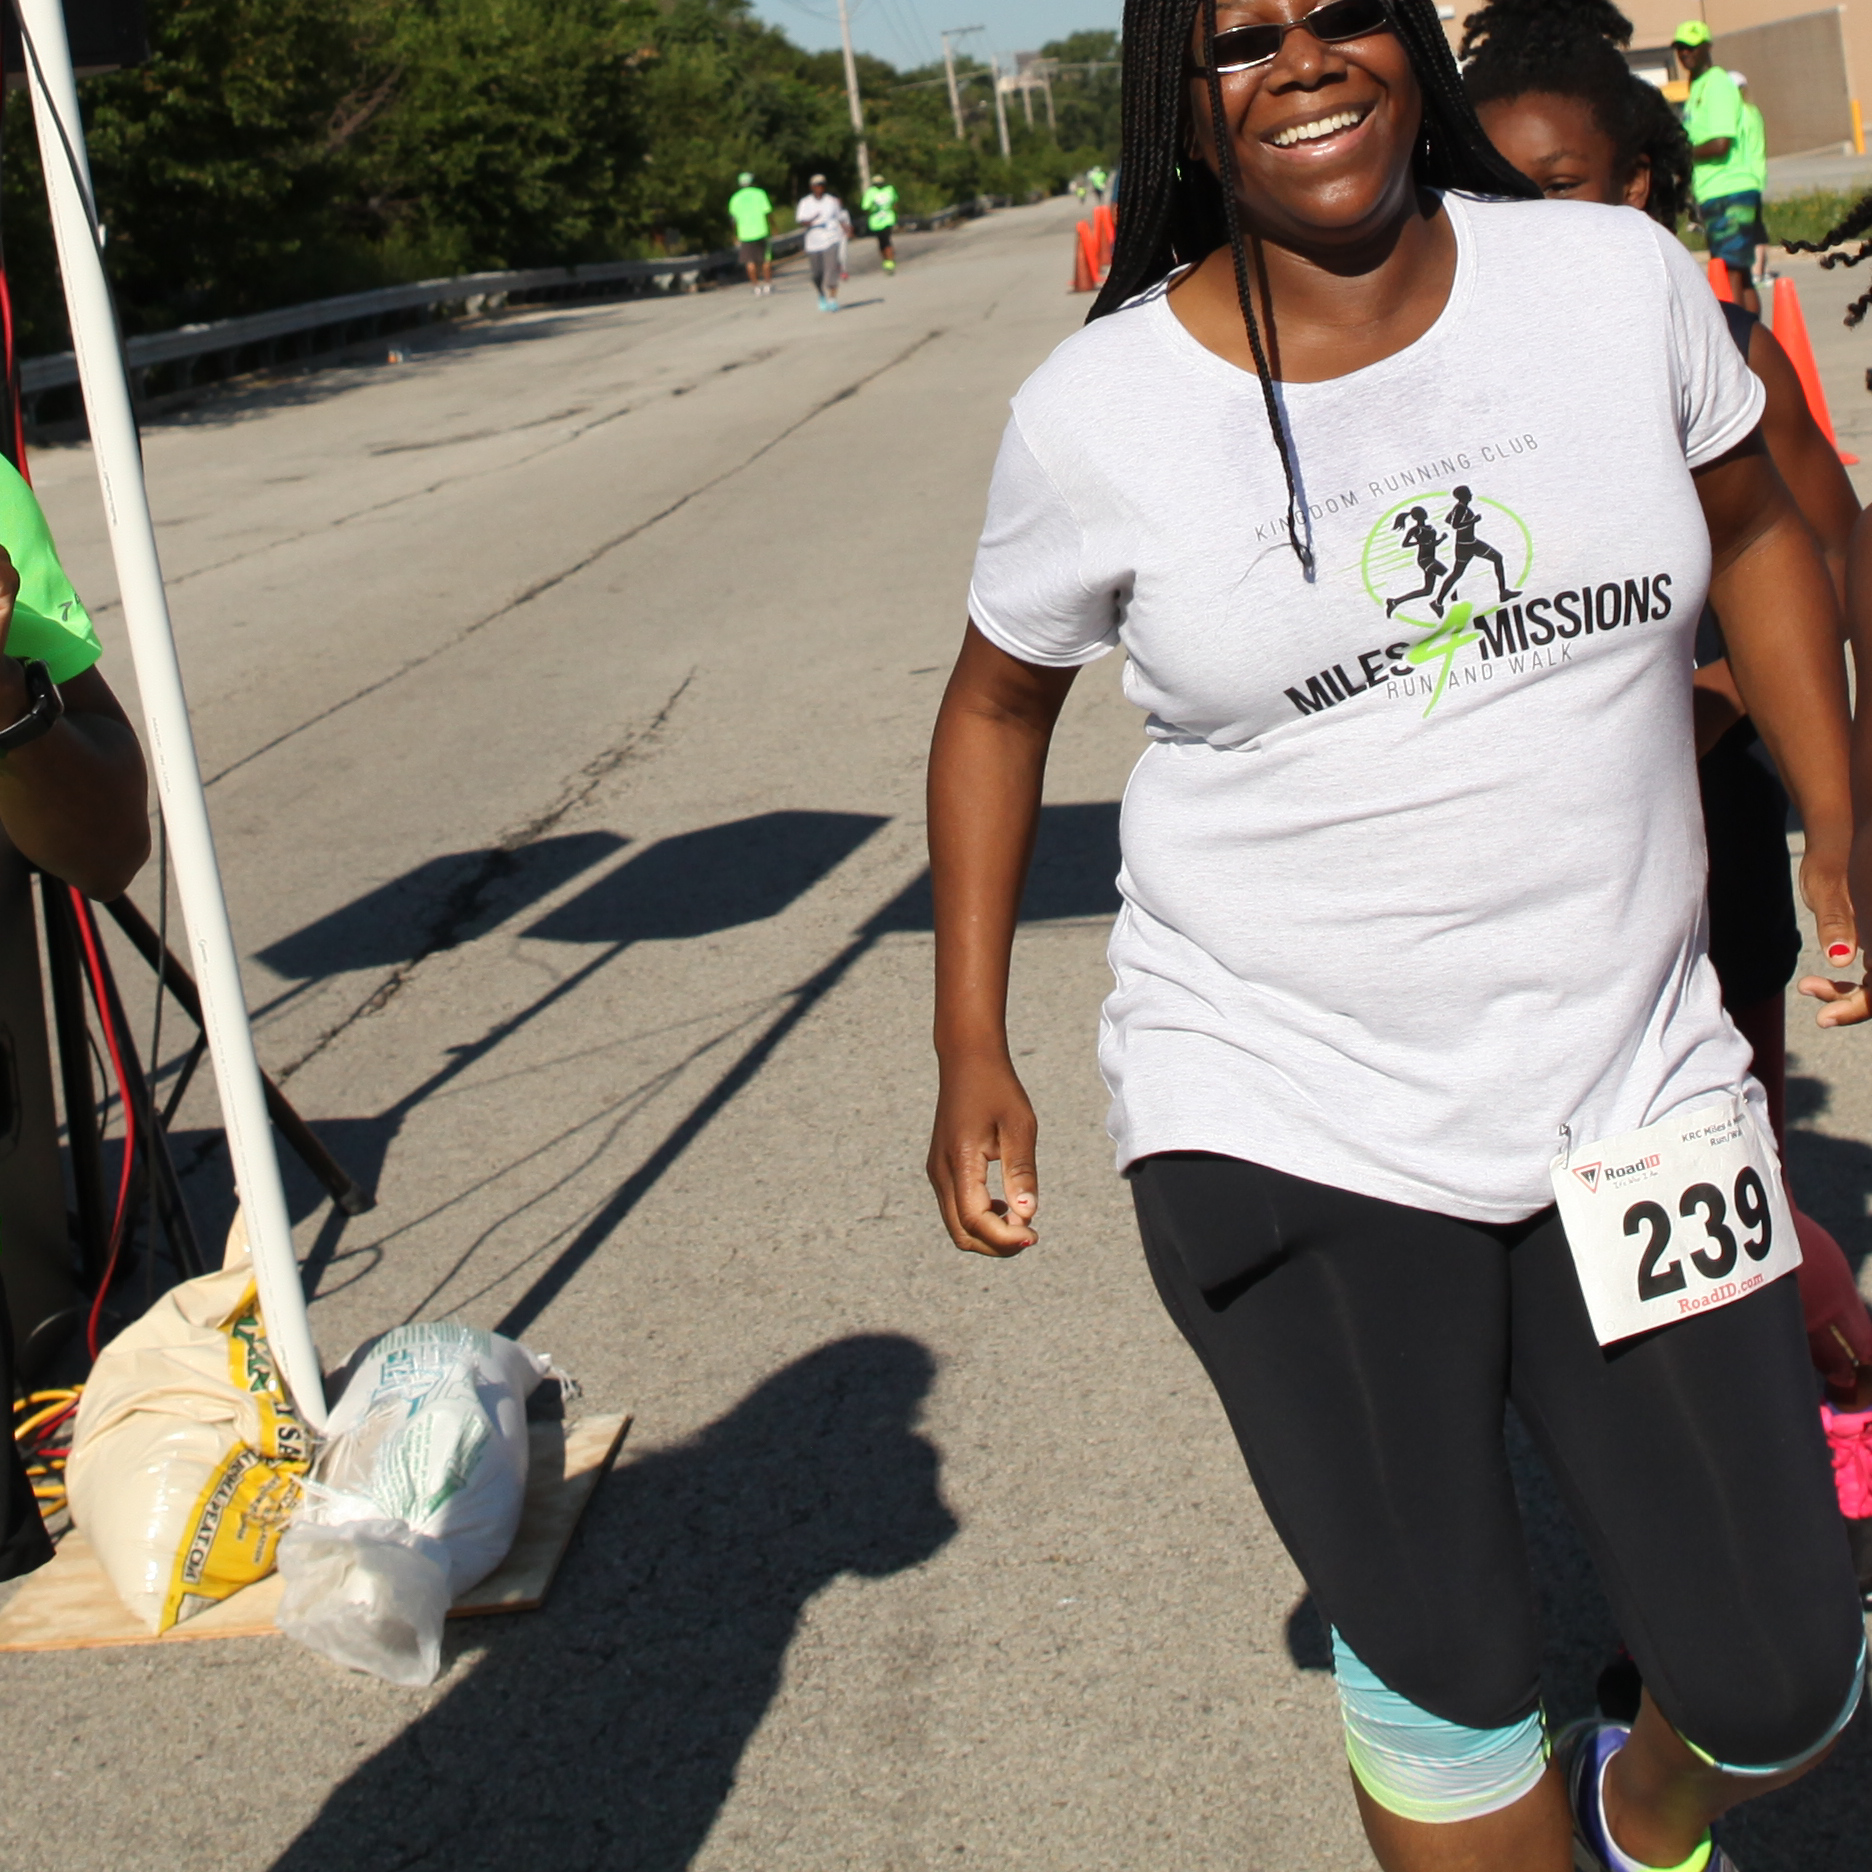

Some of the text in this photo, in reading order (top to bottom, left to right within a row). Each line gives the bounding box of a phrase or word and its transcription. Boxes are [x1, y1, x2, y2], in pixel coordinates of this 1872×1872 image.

[1254, 433, 1540, 542] KINGDOM RUNNING CLUB
[1283, 641, 1414, 715] MILES
[1473, 572, 1674, 661] MISSIONS
[1386, 641, 1574, 700] RUN AND WALK
[1681, 1129, 1703, 1143] KRC
[1604, 1153, 1661, 1182] RoadID
[1622, 1165, 1773, 1302] 239
[1677, 1272, 1765, 1315] RoadID.com
